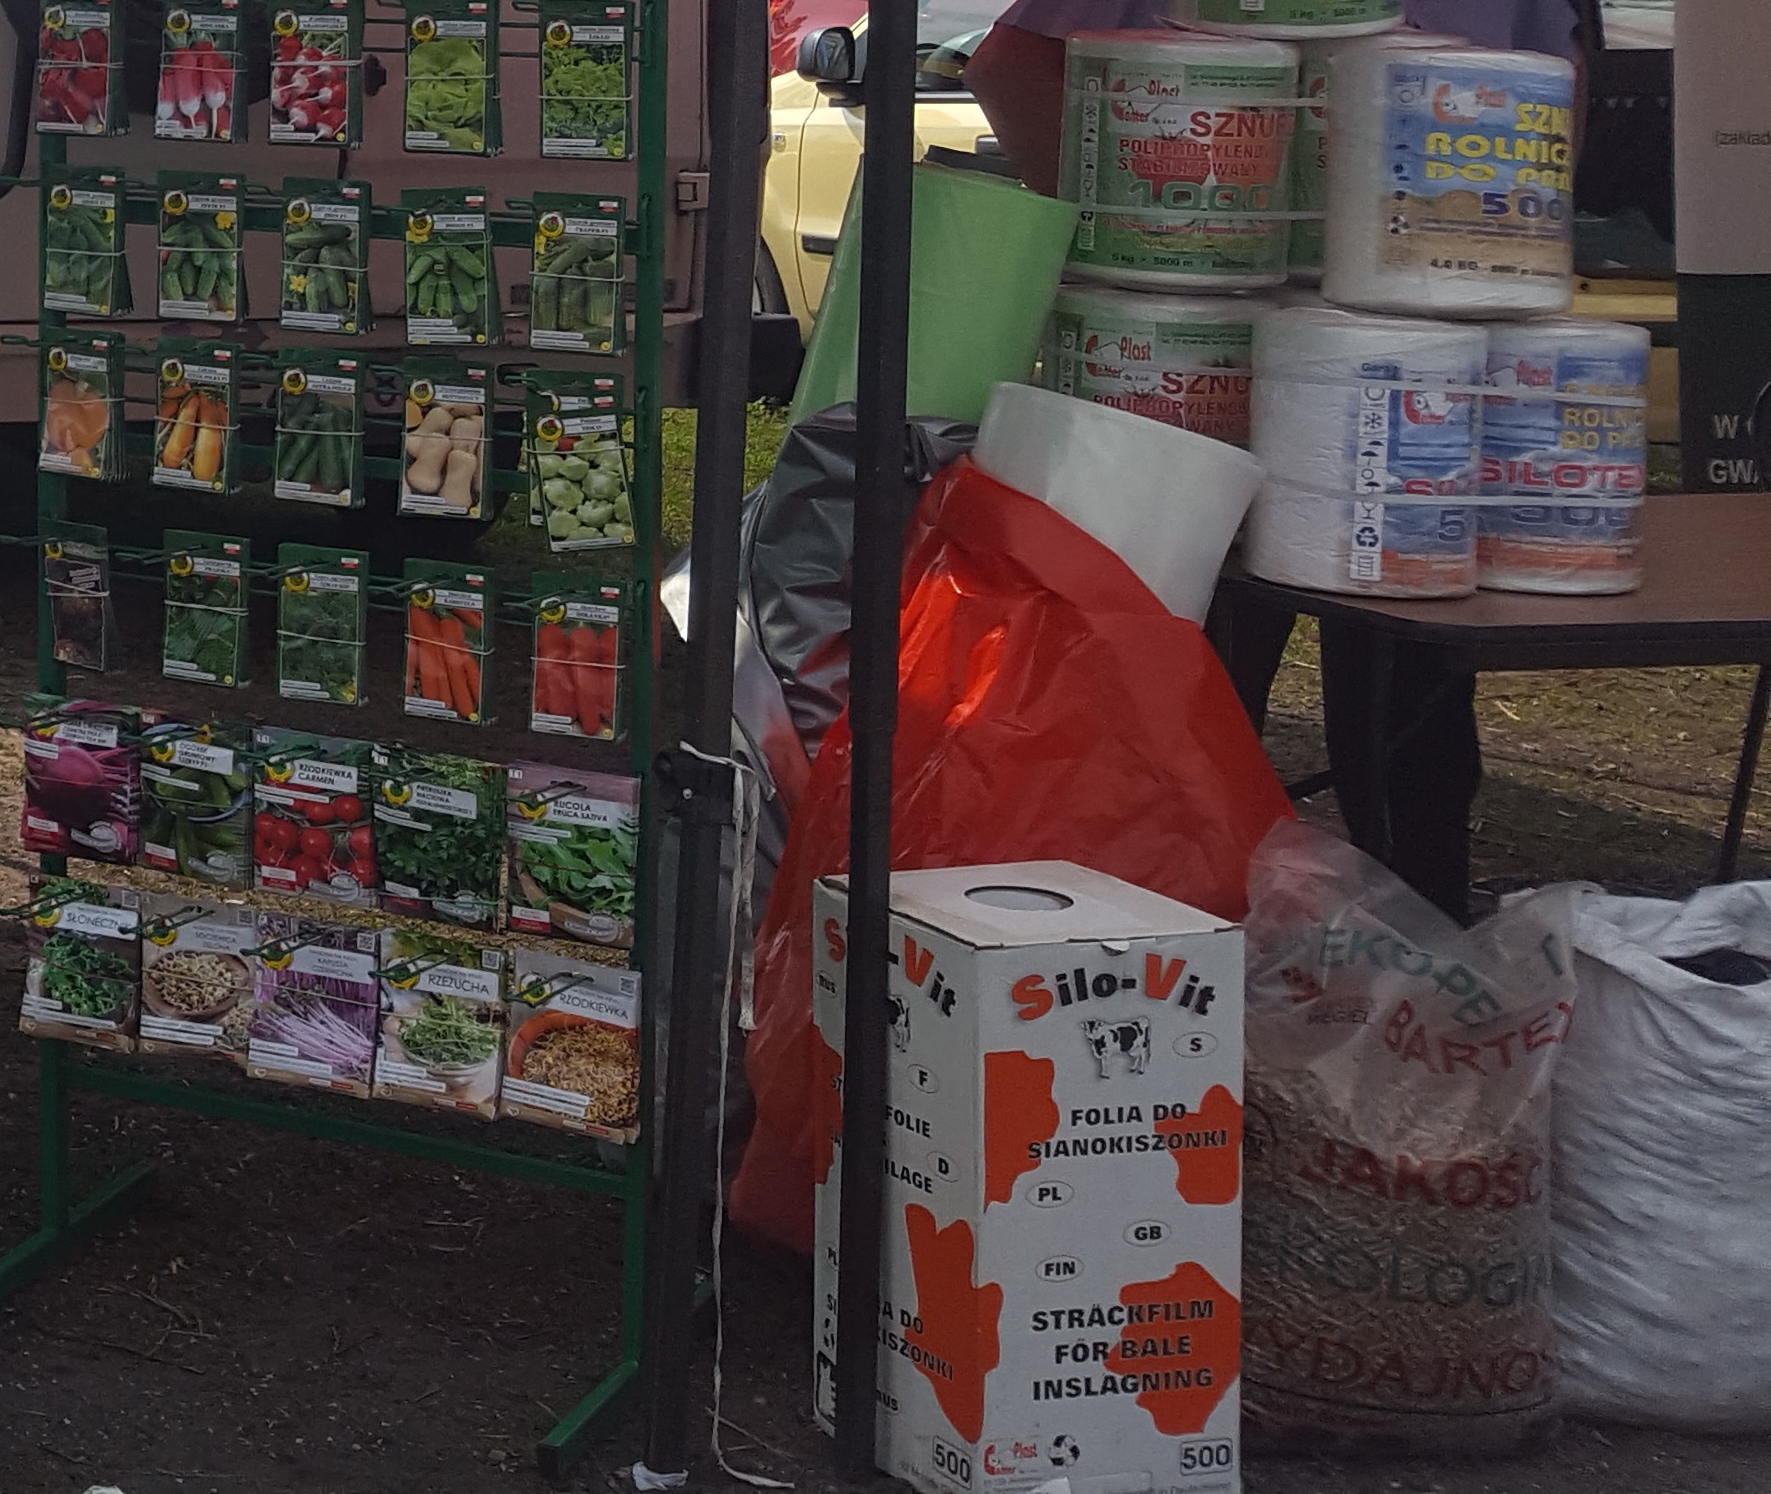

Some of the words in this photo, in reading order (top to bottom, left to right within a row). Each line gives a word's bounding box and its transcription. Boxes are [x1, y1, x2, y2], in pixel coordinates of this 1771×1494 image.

[1011, 953, 1216, 1021] Silo-Vit
[560, 993, 630, 1020] RZODKIEWKA
[1189, 1037, 1203, 1053] S
[918, 1070, 928, 1087] F
[1071, 1106, 1143, 1127] FOLIA
[1153, 1103, 1187, 1121] DO
[1027, 1129, 1228, 1160] SIANOKISZONKI
[884, 1158, 934, 1195] ILAGE
[938, 1158, 950, 1175] D
[1037, 1186, 1062, 1202] PL
[1133, 1225, 1163, 1242] GB
[1043, 1261, 1076, 1277] FIN
[900, 1309, 925, 1335] DO
[1031, 1299, 1215, 1332] STRÄCKFILM
[1054, 1337, 1109, 1365] FÖR
[1120, 1335, 1191, 1359] BALE
[1032, 1368, 1214, 1401] INSLAGNING
[934, 1446, 972, 1484] 500
[1181, 1443, 1231, 1470] 500
